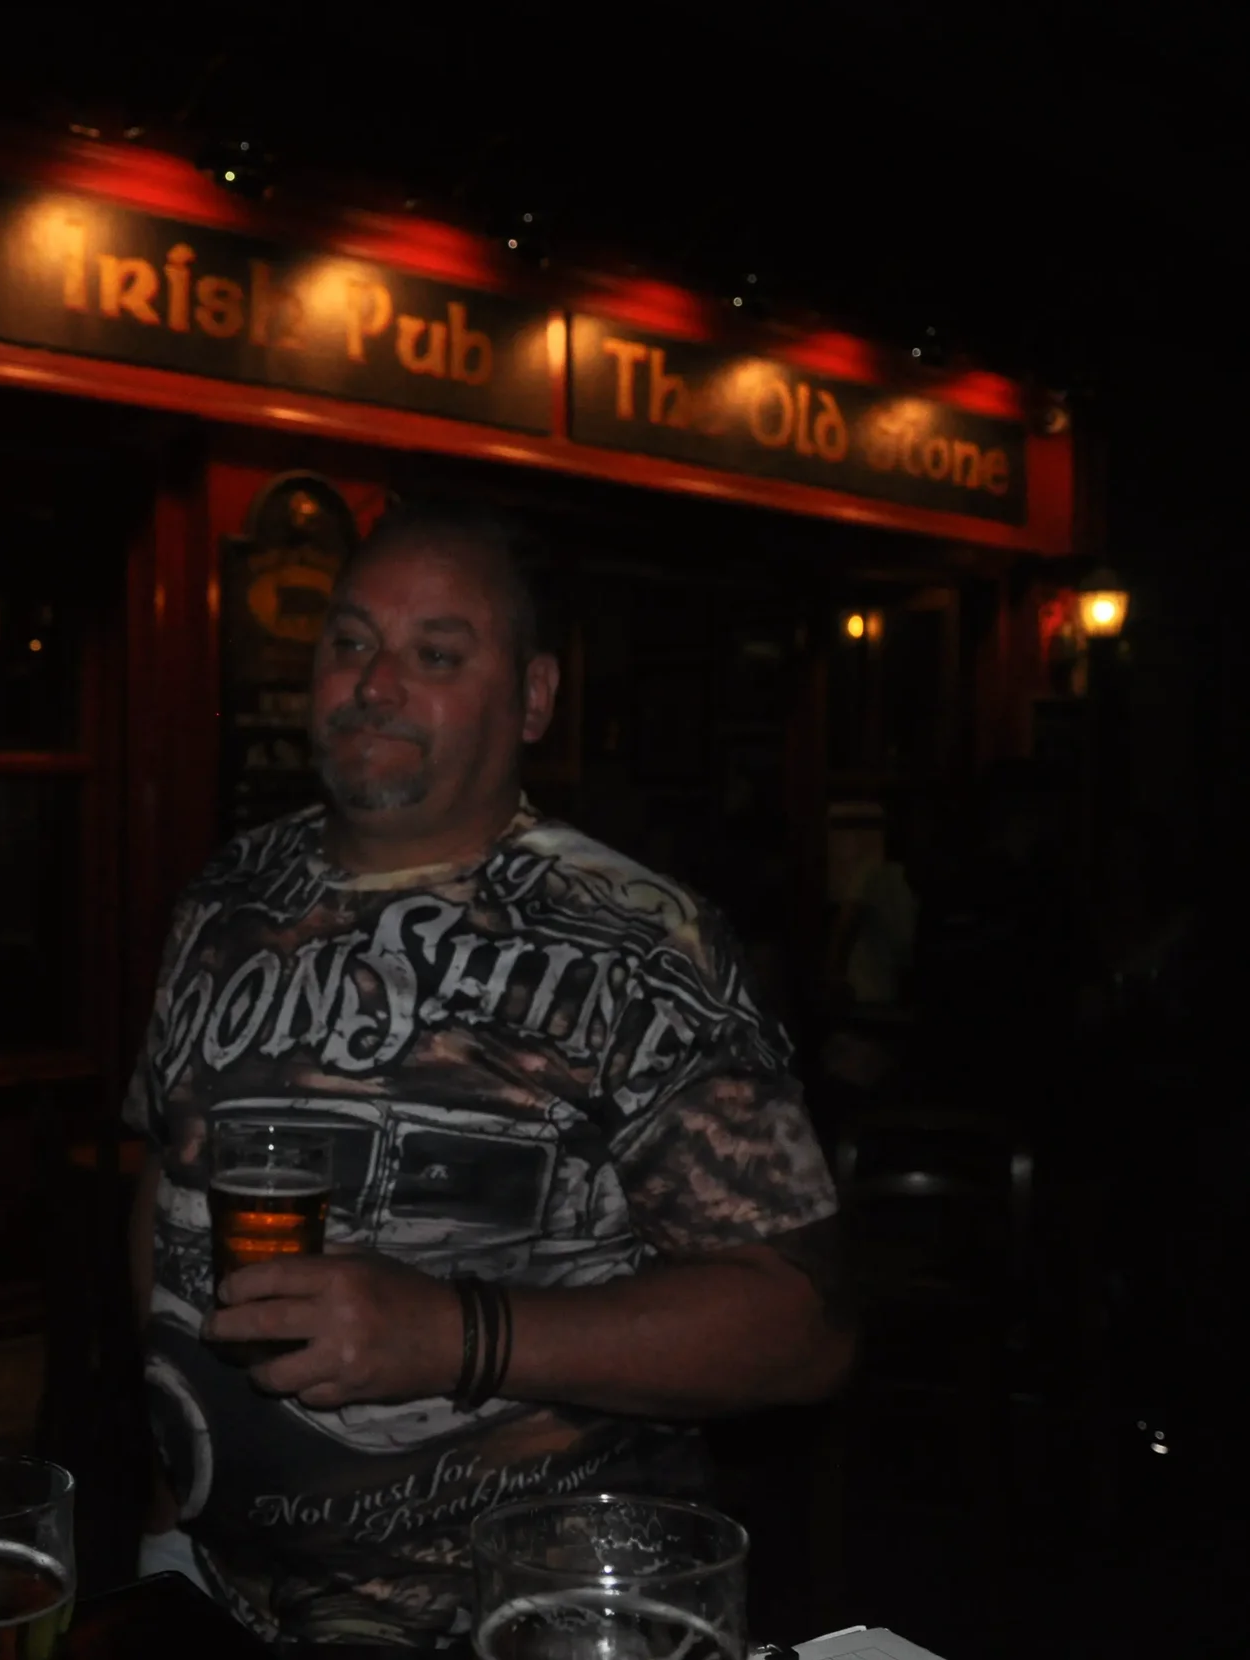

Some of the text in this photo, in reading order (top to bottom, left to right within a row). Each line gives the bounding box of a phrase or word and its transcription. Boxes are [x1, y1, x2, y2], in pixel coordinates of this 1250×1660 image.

[345, 270, 493, 385] Pub
[603, 335, 730, 436] Th
[747, 376, 848, 463] Old
[247, 1448, 482, 1527] Not just for
